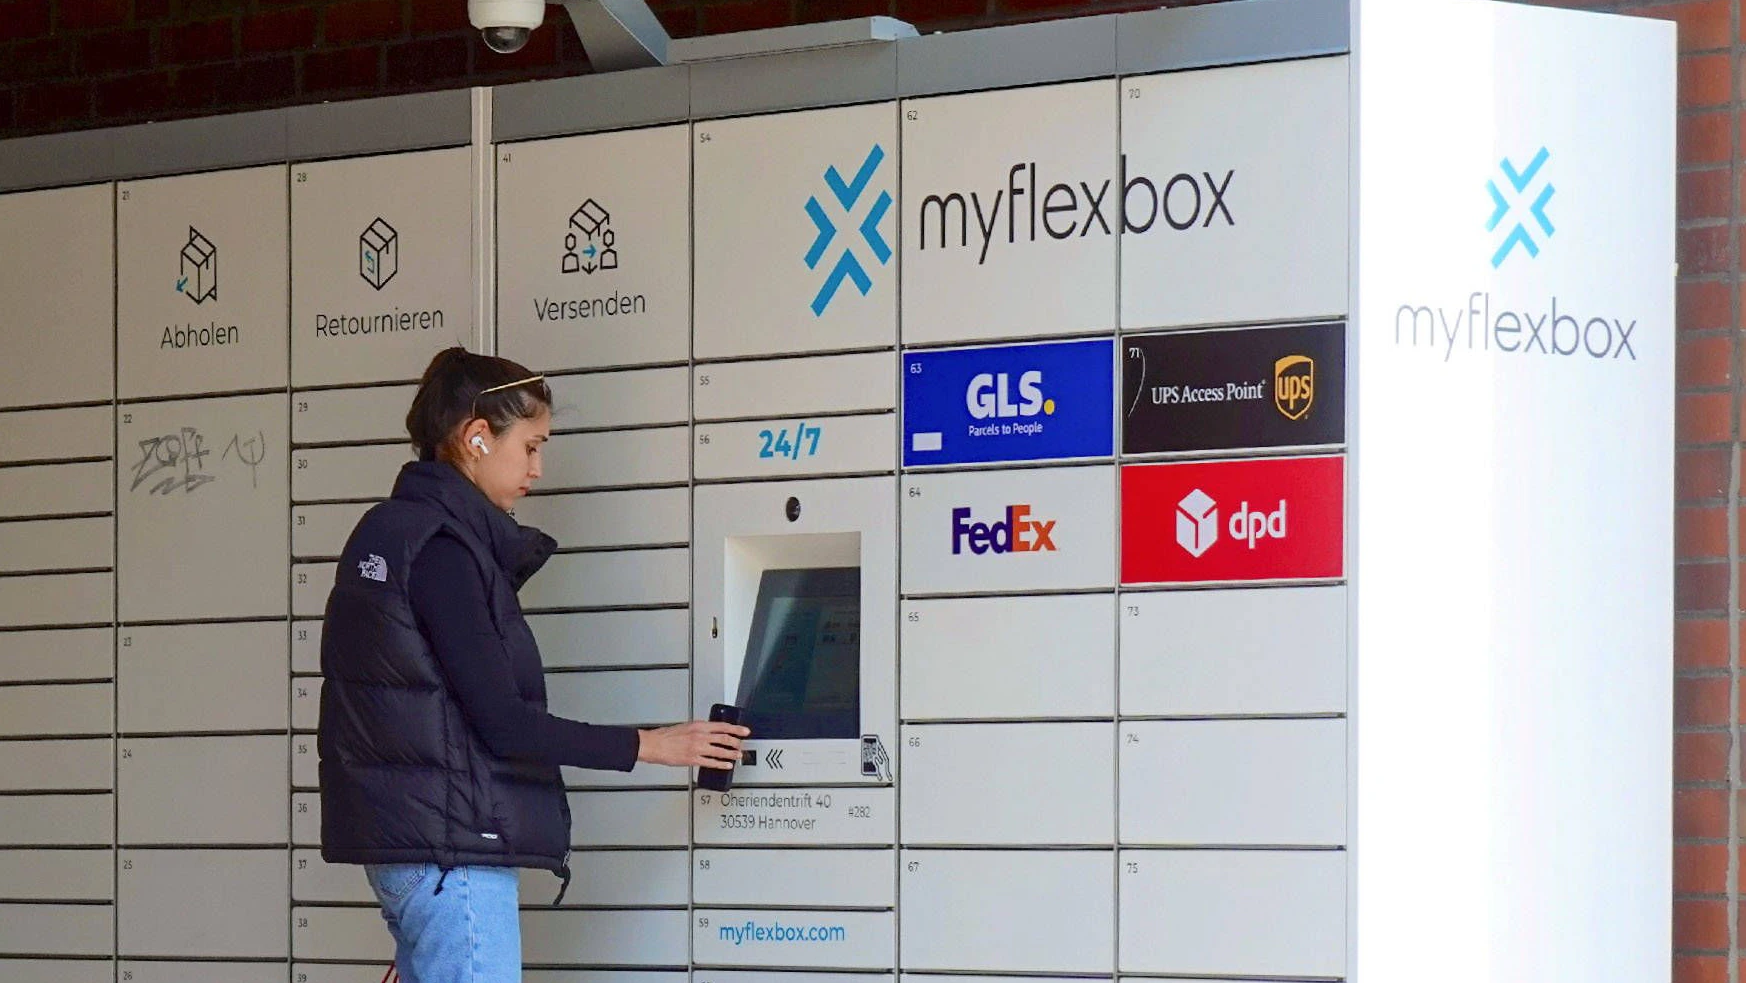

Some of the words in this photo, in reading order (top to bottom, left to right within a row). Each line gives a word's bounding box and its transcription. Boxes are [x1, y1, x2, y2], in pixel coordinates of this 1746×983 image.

[906, 110, 919, 122] 62
[700, 132, 713, 144] 54
[296, 172, 309, 184] 28
[919, 154, 1236, 265] myflexbox
[534, 290, 646, 322] Versenden
[315, 306, 444, 338] Retournieren
[1395, 291, 1637, 362] myflexbox
[160, 321, 239, 349] Abholen
[1128, 346, 1141, 359] 71
[910, 362, 923, 375] 63
[699, 375, 711, 387] 55
[1151, 387, 1180, 405] UPS
[1181, 385, 1225, 403] Access
[297, 402, 309, 414] 29
[122, 412, 134, 425] 22
[968, 423, 1000, 437] Parcels
[1001, 424, 1012, 435] to
[1013, 421, 1044, 437] People
[699, 434, 711, 446] 56
[758, 422, 821, 461] 24/7
[297, 458, 309, 471] 30
[908, 487, 922, 499] 64
[297, 515, 307, 527] 31
[1228, 499, 1287, 550] dpd
[951, 503, 1058, 555] FedEx
[297, 574, 308, 586] 32
[908, 611, 920, 623] 65
[1127, 605, 1140, 618] 73
[297, 629, 308, 642] 33
[297, 687, 309, 699] 34
[908, 736, 922, 748] 66
[1126, 733, 1140, 745] 74
[297, 743, 309, 756] 35
[700, 794, 712, 806] 57
[816, 794, 832, 809] 40
[297, 802, 309, 814] 36
[848, 805, 871, 819] #282
[720, 815, 756, 830] 30539
[758, 815, 817, 831] Hannover
[122, 859, 134, 871] 25
[297, 858, 309, 871] 37
[699, 859, 711, 871] 58
[907, 861, 920, 873] 67
[1126, 862, 1139, 875] 75
[297, 917, 309, 929] 38
[698, 917, 710, 929] 59
[719, 921, 846, 945] myflexbox.com
